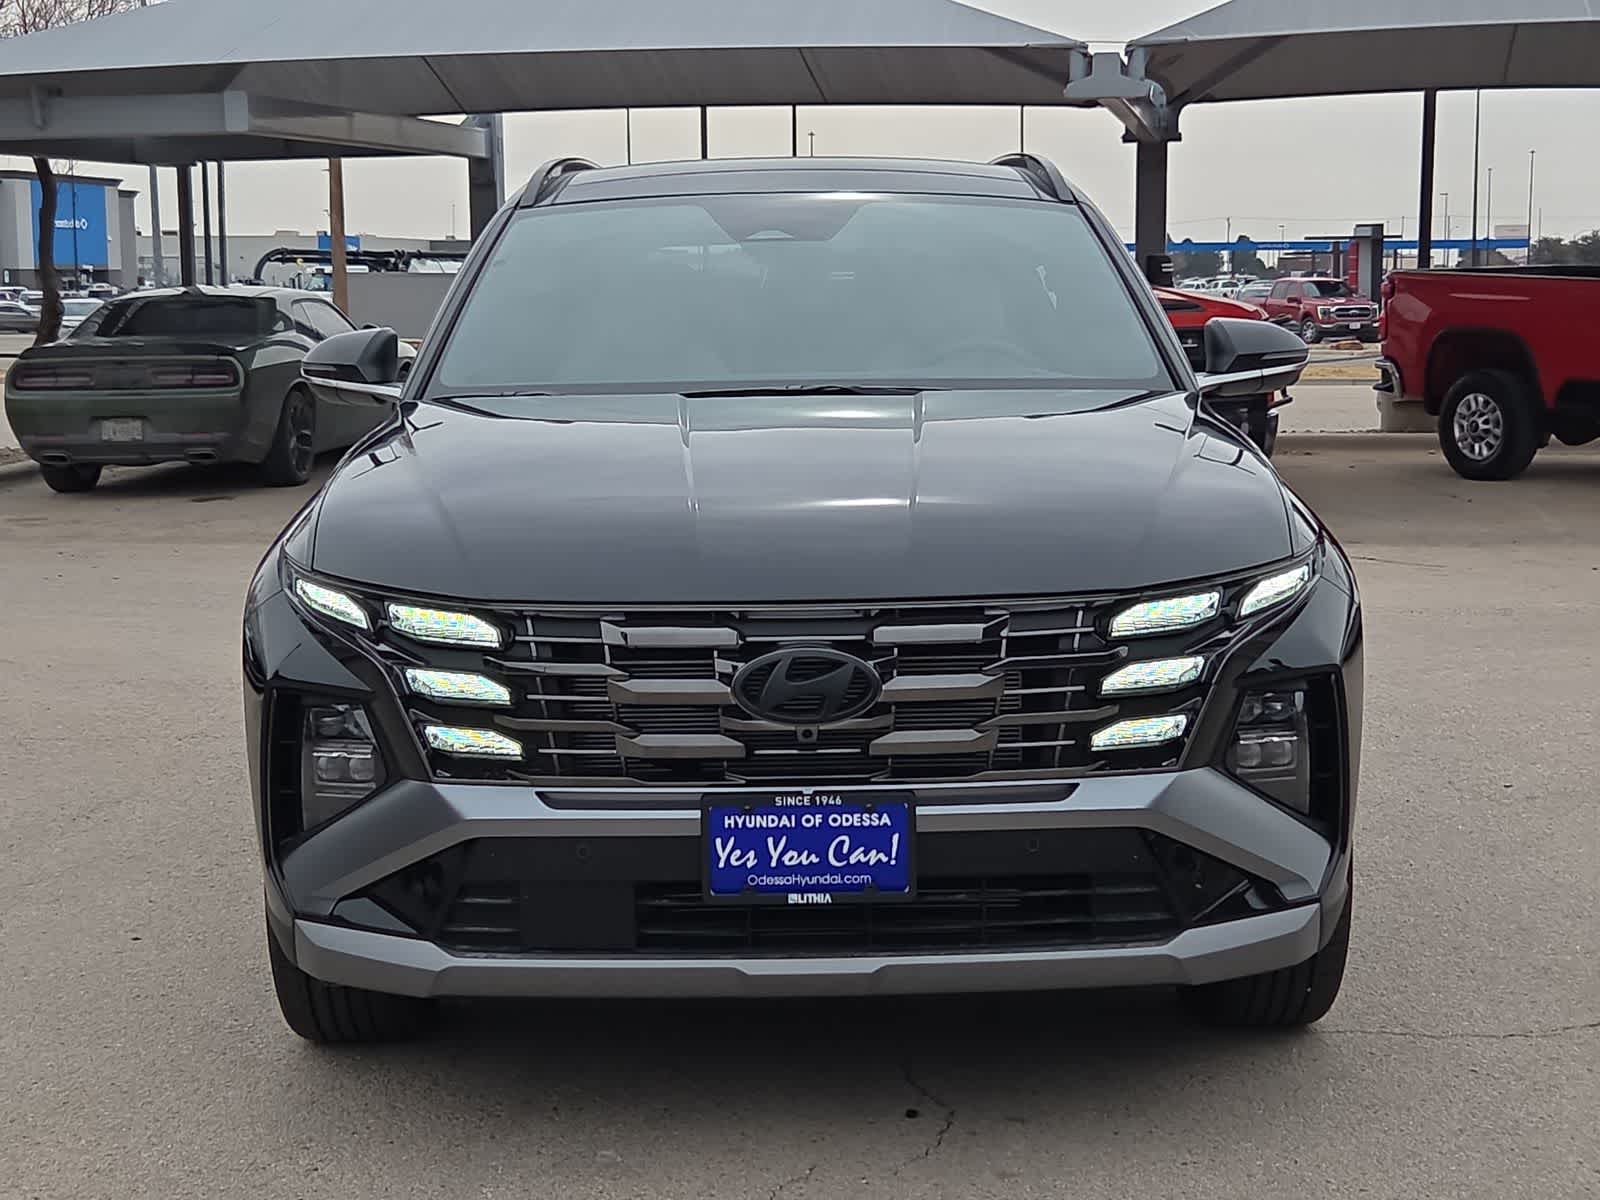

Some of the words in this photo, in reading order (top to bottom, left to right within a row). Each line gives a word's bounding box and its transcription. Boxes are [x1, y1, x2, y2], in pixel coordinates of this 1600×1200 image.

[775, 796, 811, 806] SINCE
[814, 795, 842, 806] 1946
[724, 814, 795, 829] HYUNDAI
[801, 814, 823, 828] OF
[828, 813, 891, 827] ODESSA
[714, 835, 758, 869] Yes
[766, 835, 820, 868] You
[828, 832, 900, 867] Can!
[747, 873, 872, 888] OdessaHyundai.com
[797, 893, 833, 904] LITHIA
